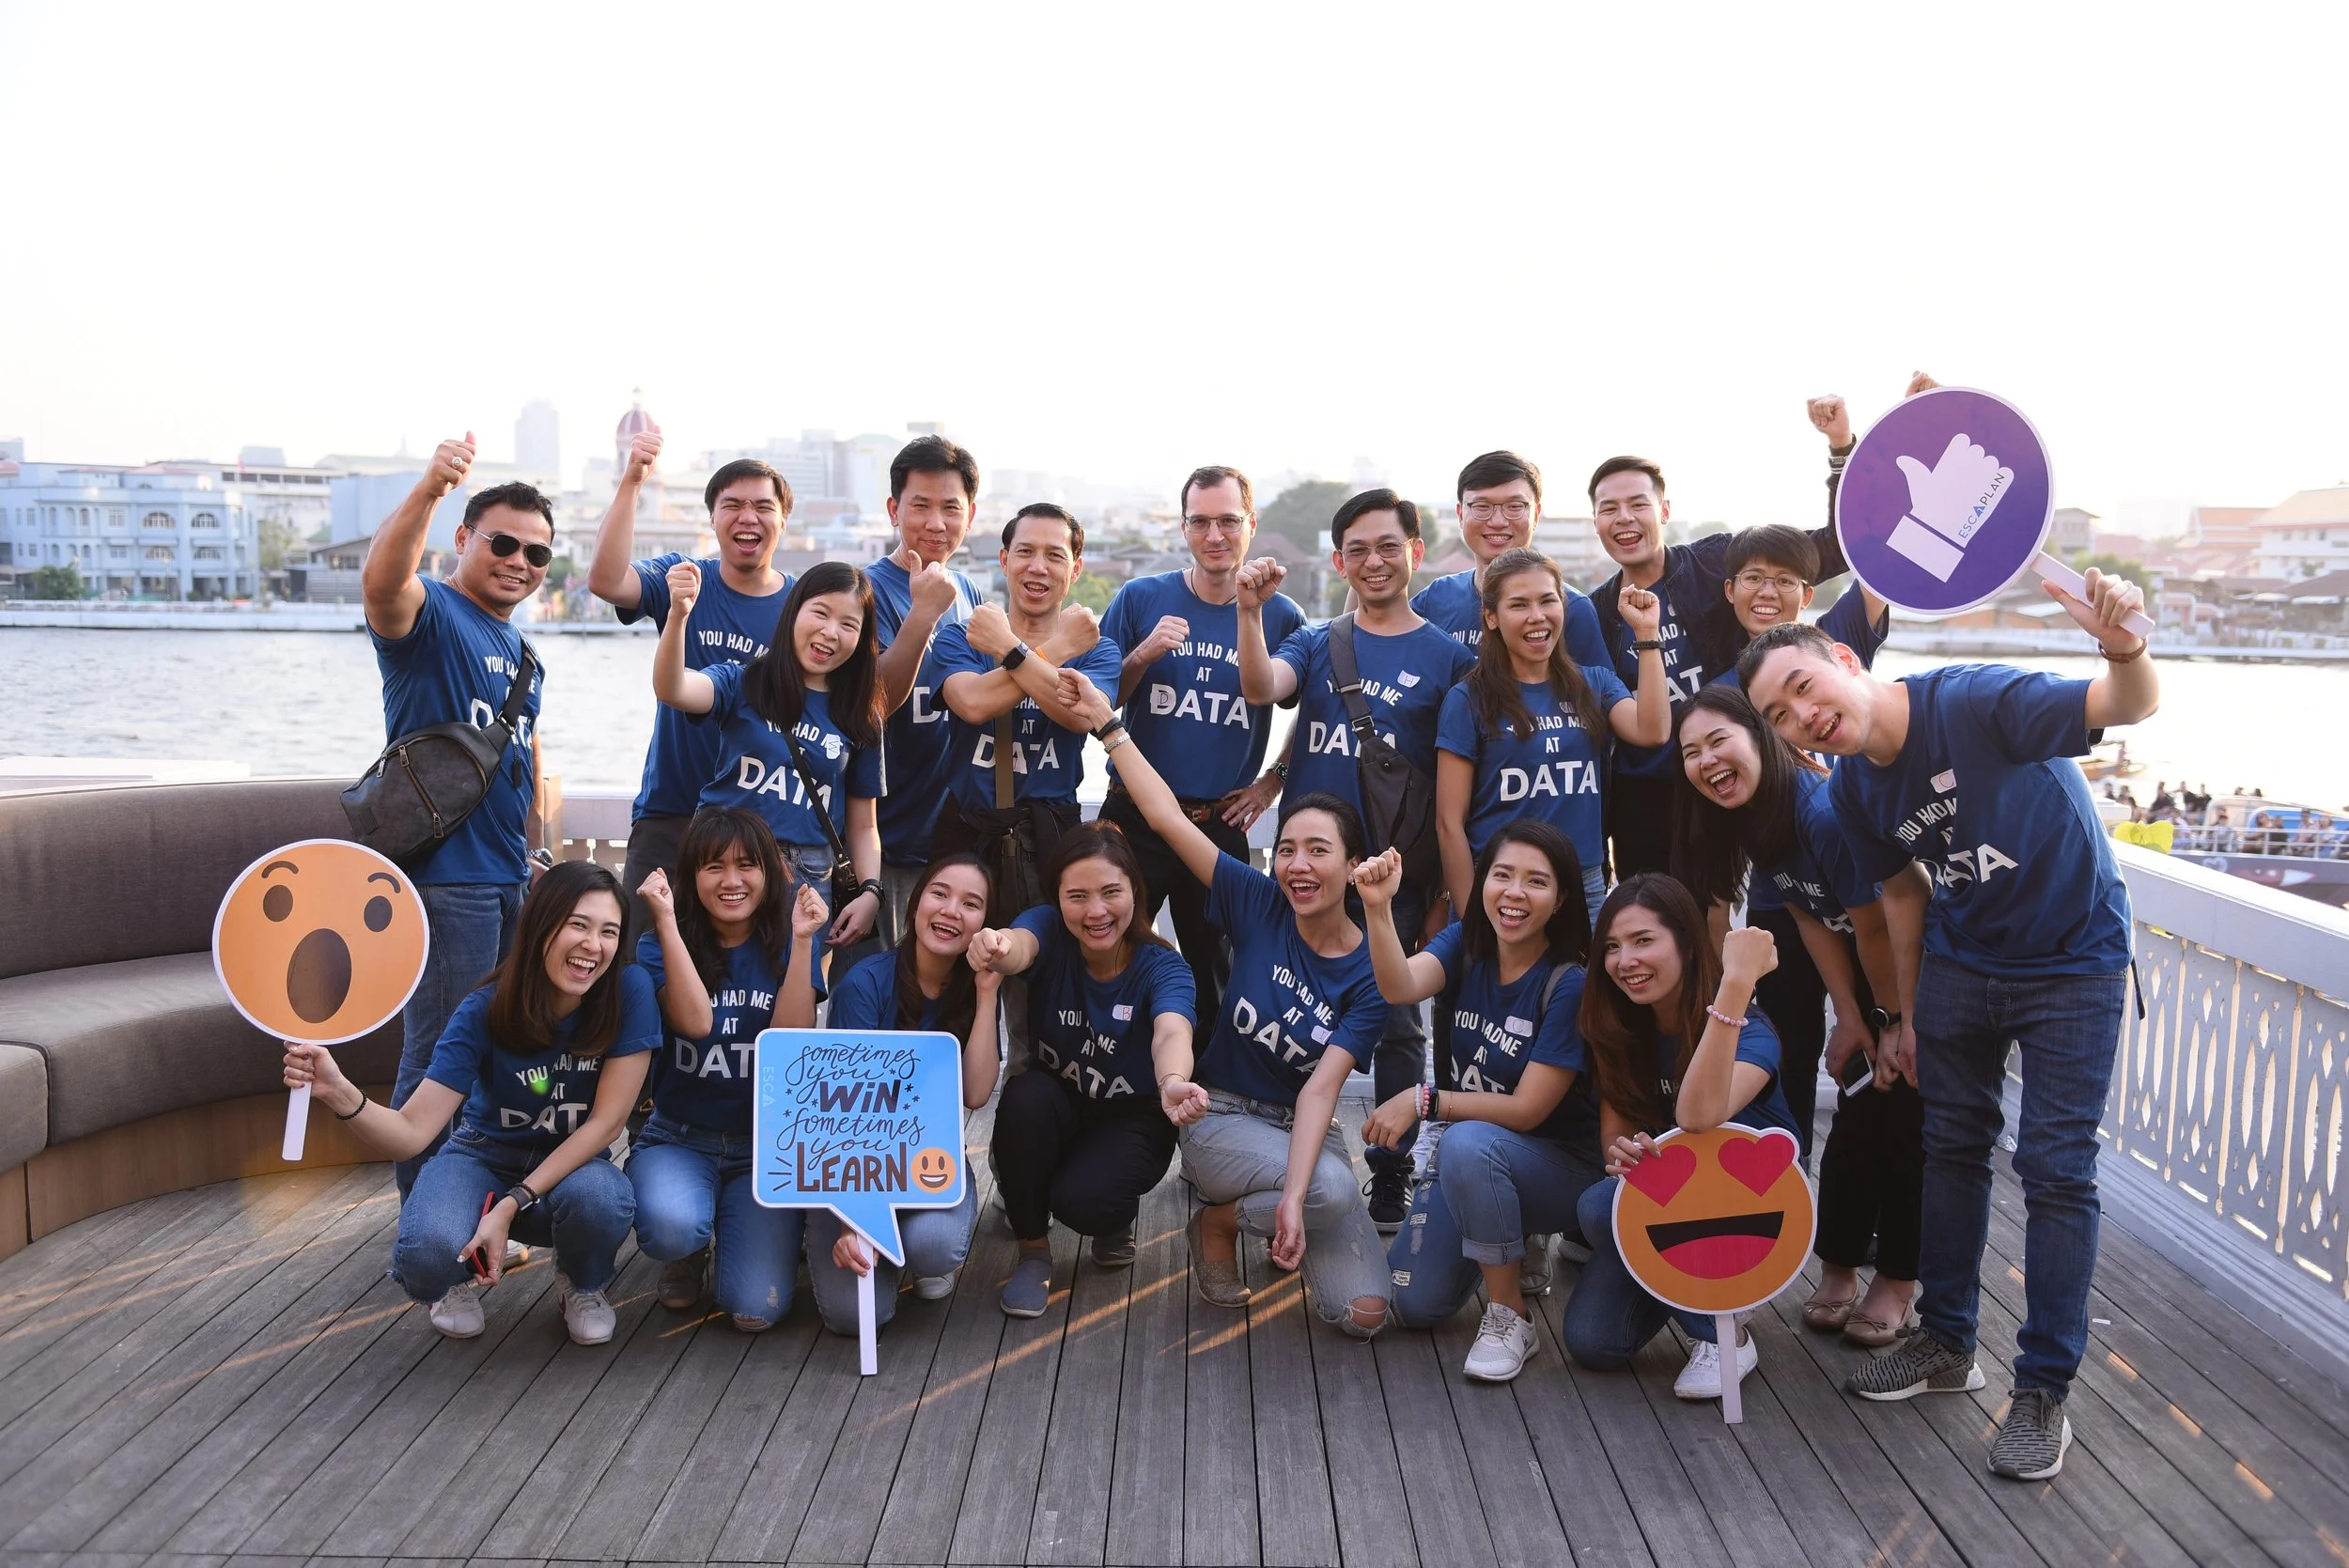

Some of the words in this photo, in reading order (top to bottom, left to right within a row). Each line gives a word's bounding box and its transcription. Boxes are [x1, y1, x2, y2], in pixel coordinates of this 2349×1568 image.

[1658, 623, 1679, 643] AD
[698, 630, 723, 646] YOU
[726, 633, 754, 654] HAD
[754, 644, 770, 659] M
[1197, 642, 1222, 660] HAD
[485, 656, 505, 674] YOU
[1663, 648, 1678, 667] AT
[1195, 666, 1212, 682] AT
[1150, 683, 1250, 730] DATA
[1379, 686, 1404, 706] ME
[791, 722, 820, 742] HAD
[1021, 719, 1035, 735] AT
[1536, 716, 1563, 731] HAD
[1546, 737, 1560, 753] AT
[1500, 760, 1599, 801] DATA
[1894, 819, 1922, 846] YOU
[1915, 802, 1948, 826] HAD
[1944, 798, 1957, 815] M
[1802, 881, 1825, 897] ME
[722, 989, 746, 1007] HAD
[750, 989, 773, 1011] ME
[1271, 964, 1296, 988] YOU
[1313, 1001, 1335, 1026] ME
[722, 1017, 739, 1034] AT
[1058, 1010, 1082, 1027] YOU
[1283, 1006, 1304, 1026] AT
[1097, 1033, 1117, 1055] ME
[1455, 1010, 1479, 1031] YOU
[1499, 1032, 1522, 1058] ME
[675, 1036, 754, 1079] DAT
[515, 1065, 549, 1086] YOU
[577, 1056, 600, 1071] ME
[1038, 1039, 1135, 1099] DATA
[551, 1082, 565, 1100] AT
[796, 1063, 885, 1105] you
[500, 1102, 588, 1135] DAT
[808, 1138, 891, 1171] you
[797, 1141, 908, 1192] LEARN
